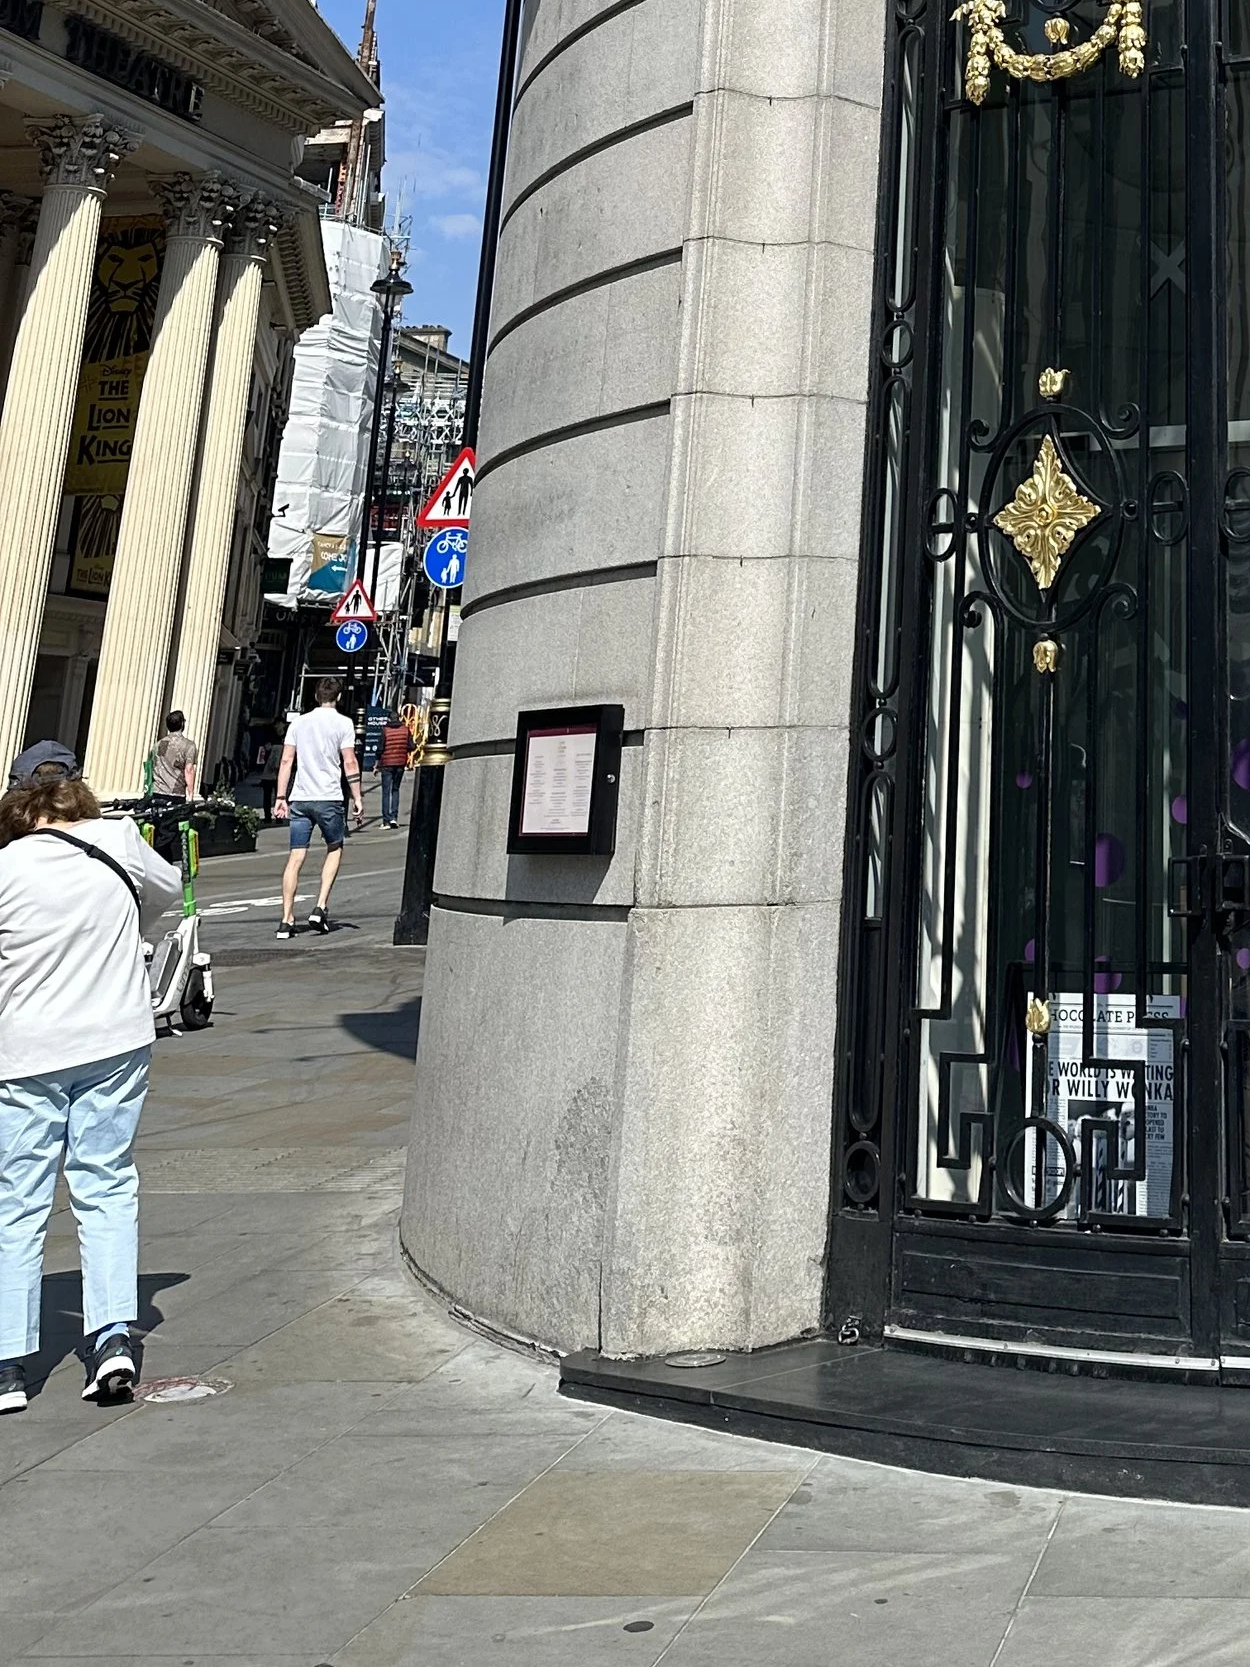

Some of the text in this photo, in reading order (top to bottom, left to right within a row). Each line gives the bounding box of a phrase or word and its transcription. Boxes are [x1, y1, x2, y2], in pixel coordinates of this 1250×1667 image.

[64, 13, 205, 122] THEATRE
[100, 363, 132, 378] Disney
[98, 379, 129, 397] THE
[1067, 1079, 1110, 1098] WILLY
[1116, 1081, 1174, 1101] WNKA
